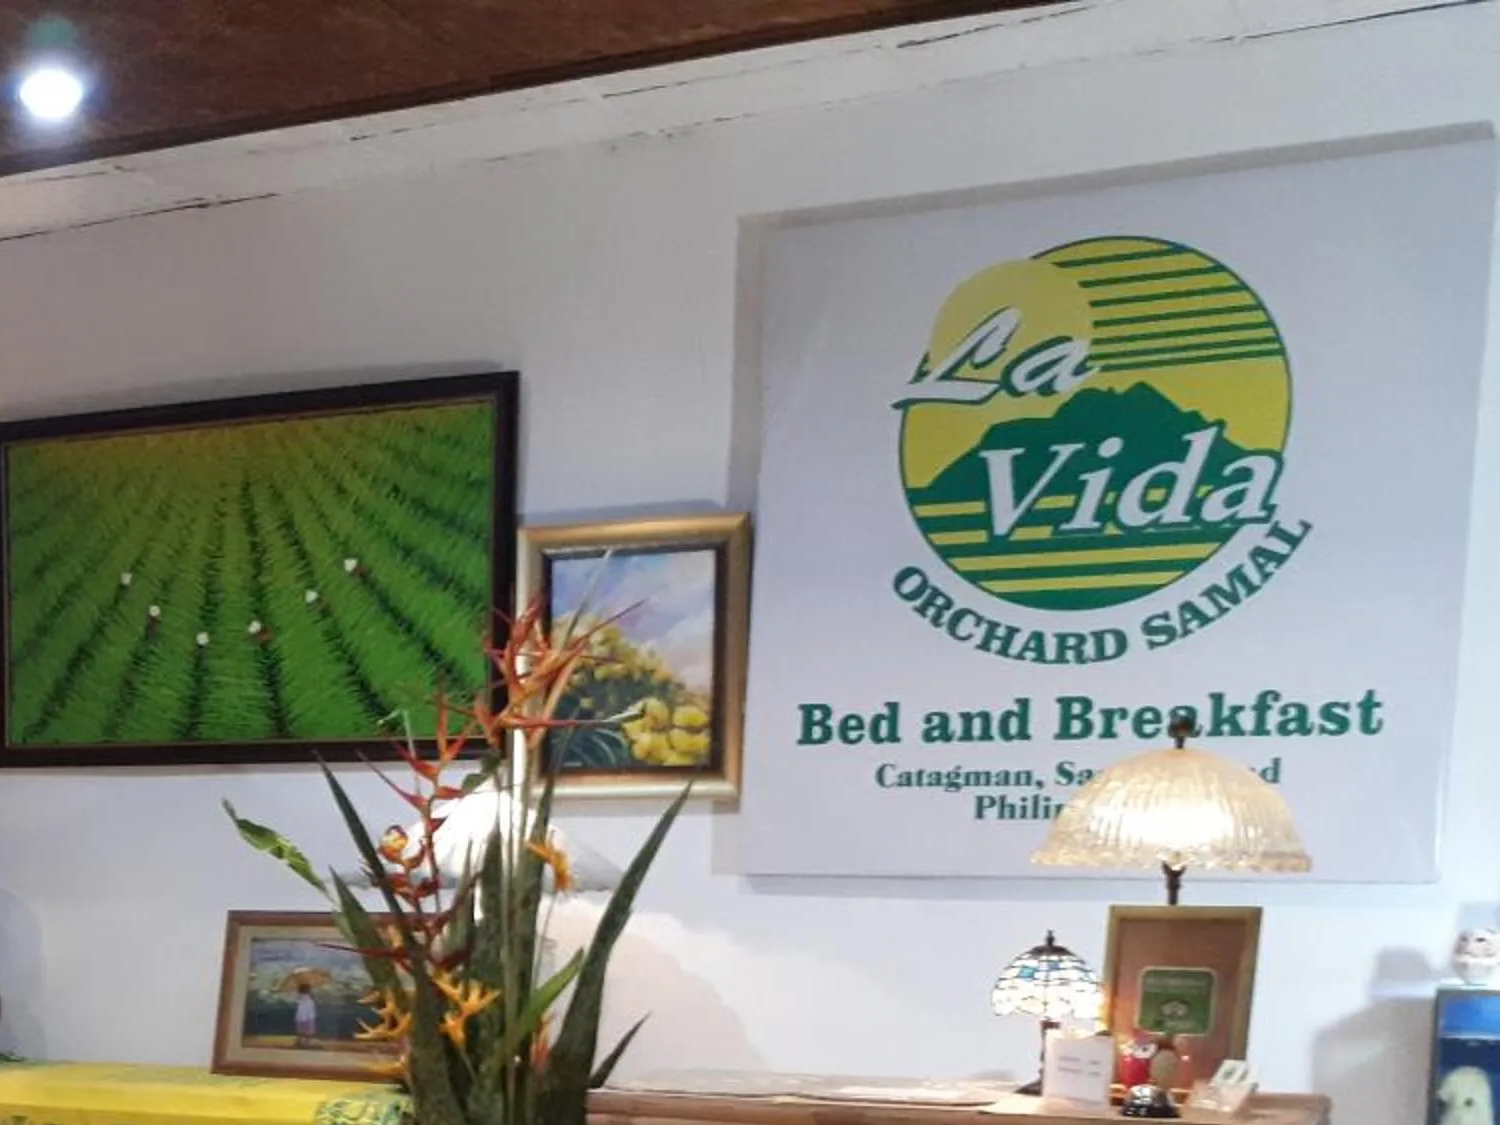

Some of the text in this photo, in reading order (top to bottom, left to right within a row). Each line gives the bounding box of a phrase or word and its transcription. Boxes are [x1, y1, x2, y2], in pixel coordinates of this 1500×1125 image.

[892, 304, 1102, 411] La
[978, 423, 1282, 539] Vida
[892, 516, 1314, 665] ORCHARD SAMAL
[796, 701, 902, 746] Bed
[921, 697, 1032, 744] and
[874, 762, 1045, 793] Catagman,
